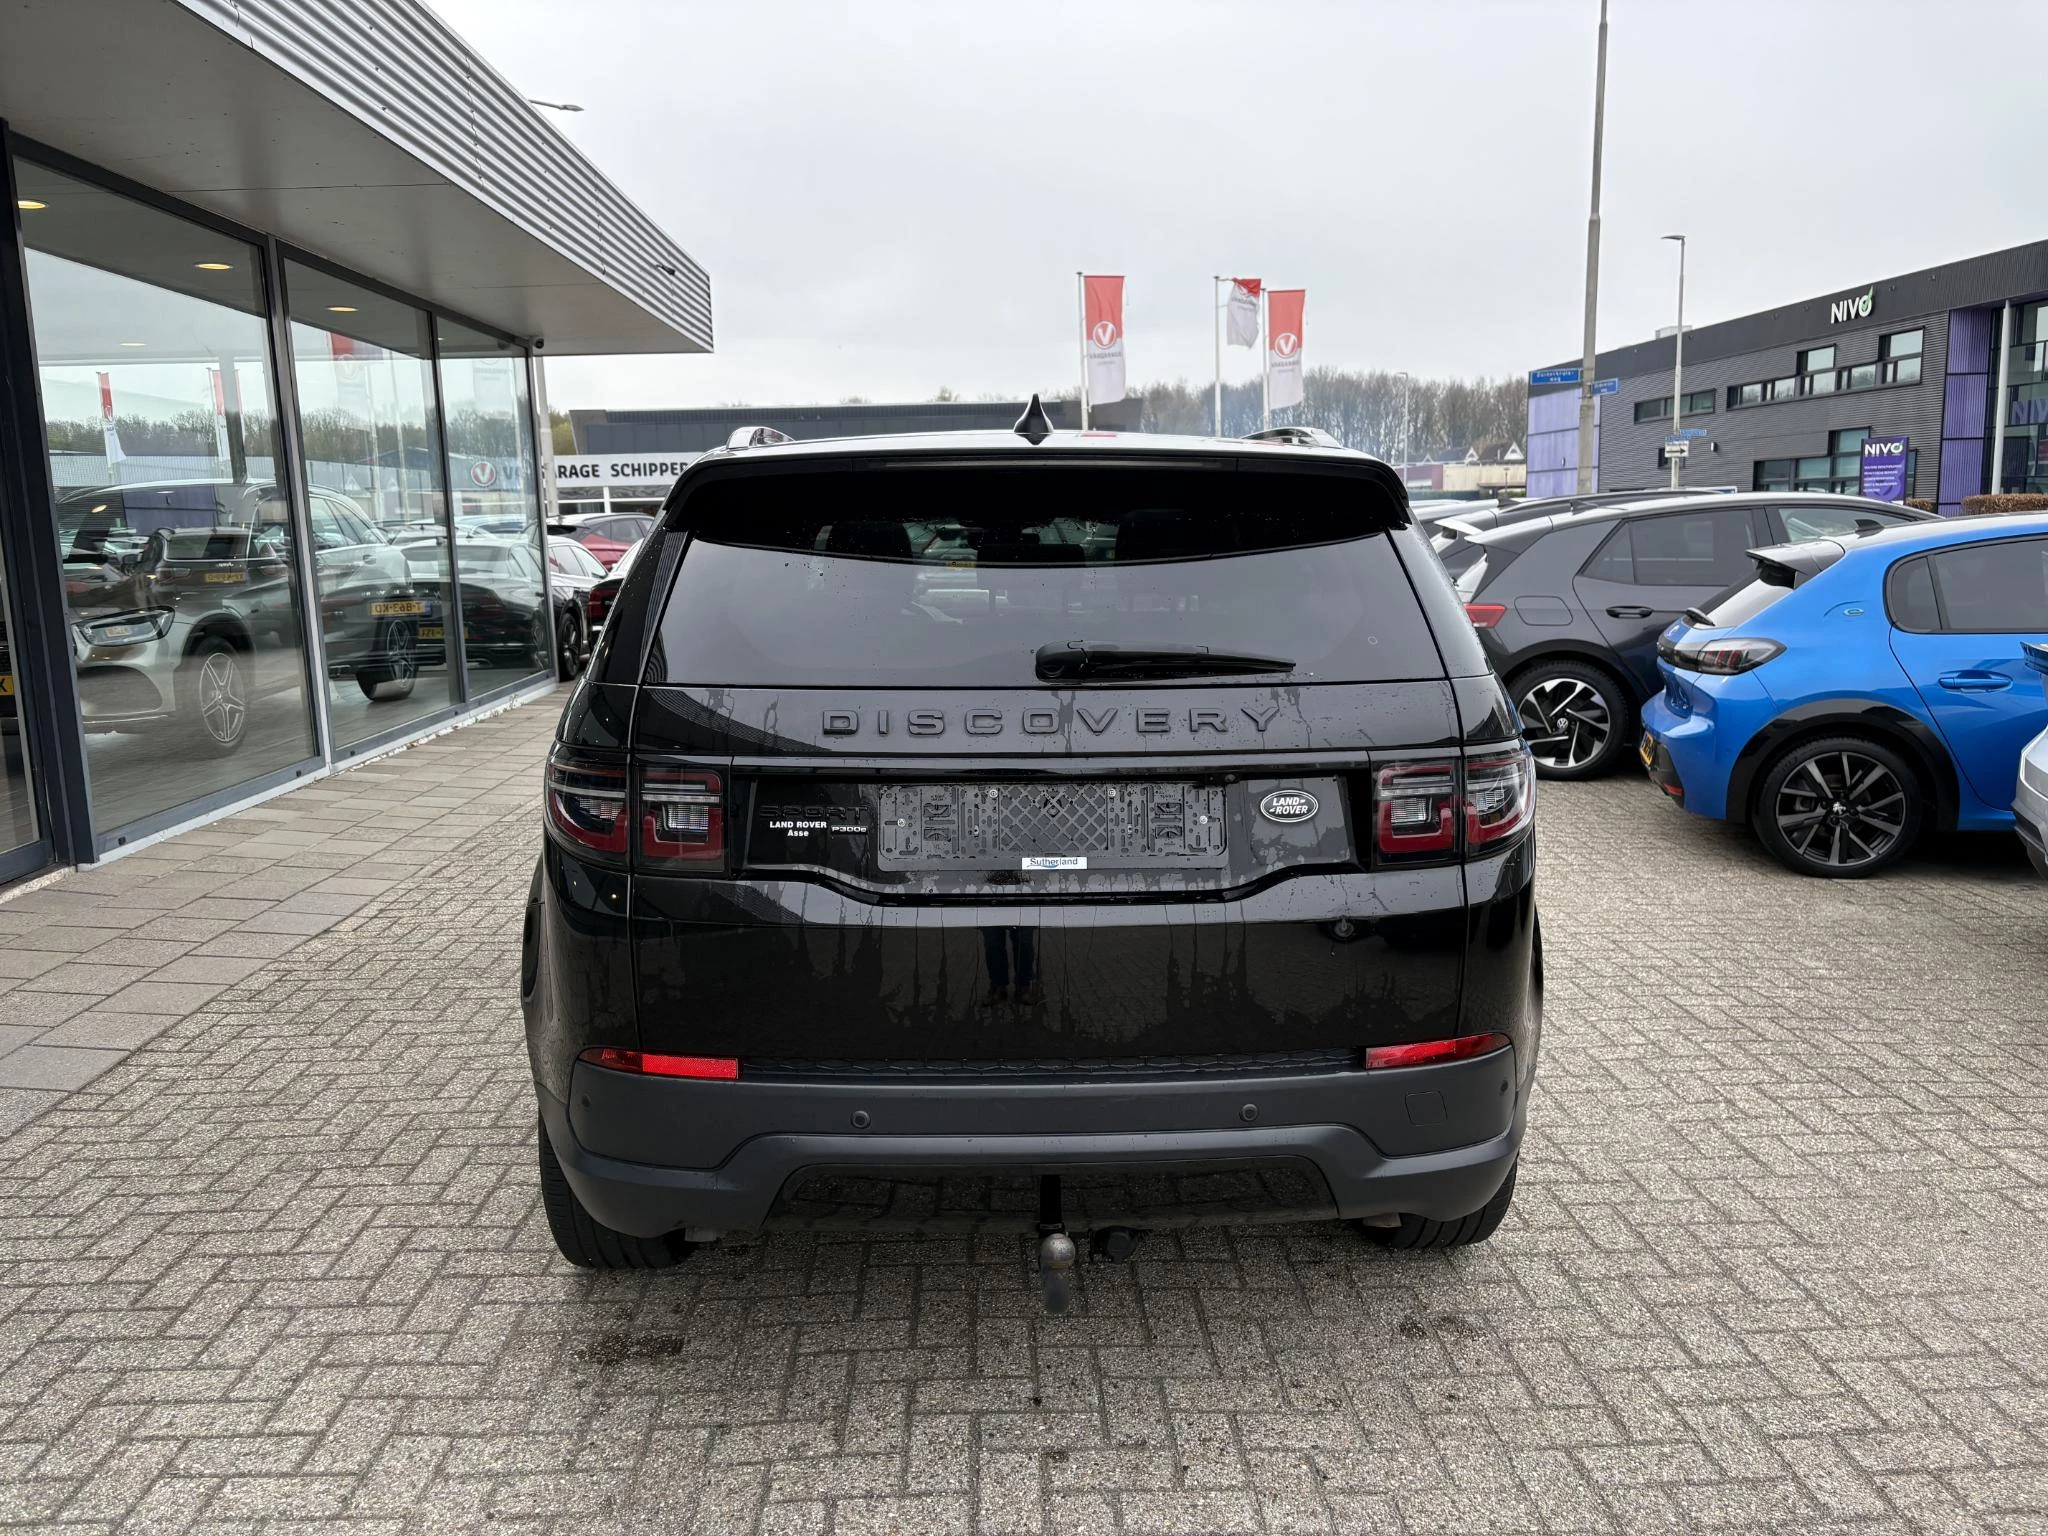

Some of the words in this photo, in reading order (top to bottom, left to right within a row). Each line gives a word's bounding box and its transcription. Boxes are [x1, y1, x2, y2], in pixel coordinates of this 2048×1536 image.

[1830, 291, 1873, 324] NIVO
[1864, 441, 1903, 457] NIVO
[555, 464, 600, 479] RAGE
[822, 706, 1281, 737] DISCOVERY
[1272, 796, 1300, 806] LAND
[759, 804, 868, 819] SPORT
[1275, 805, 1309, 815] ROVER
[769, 821, 794, 829] LAND
[796, 821, 827, 829] ROVER
[831, 825, 867, 834] P300e
[787, 829, 809, 837] Asse
[1030, 857, 1078, 866] Sutherland
